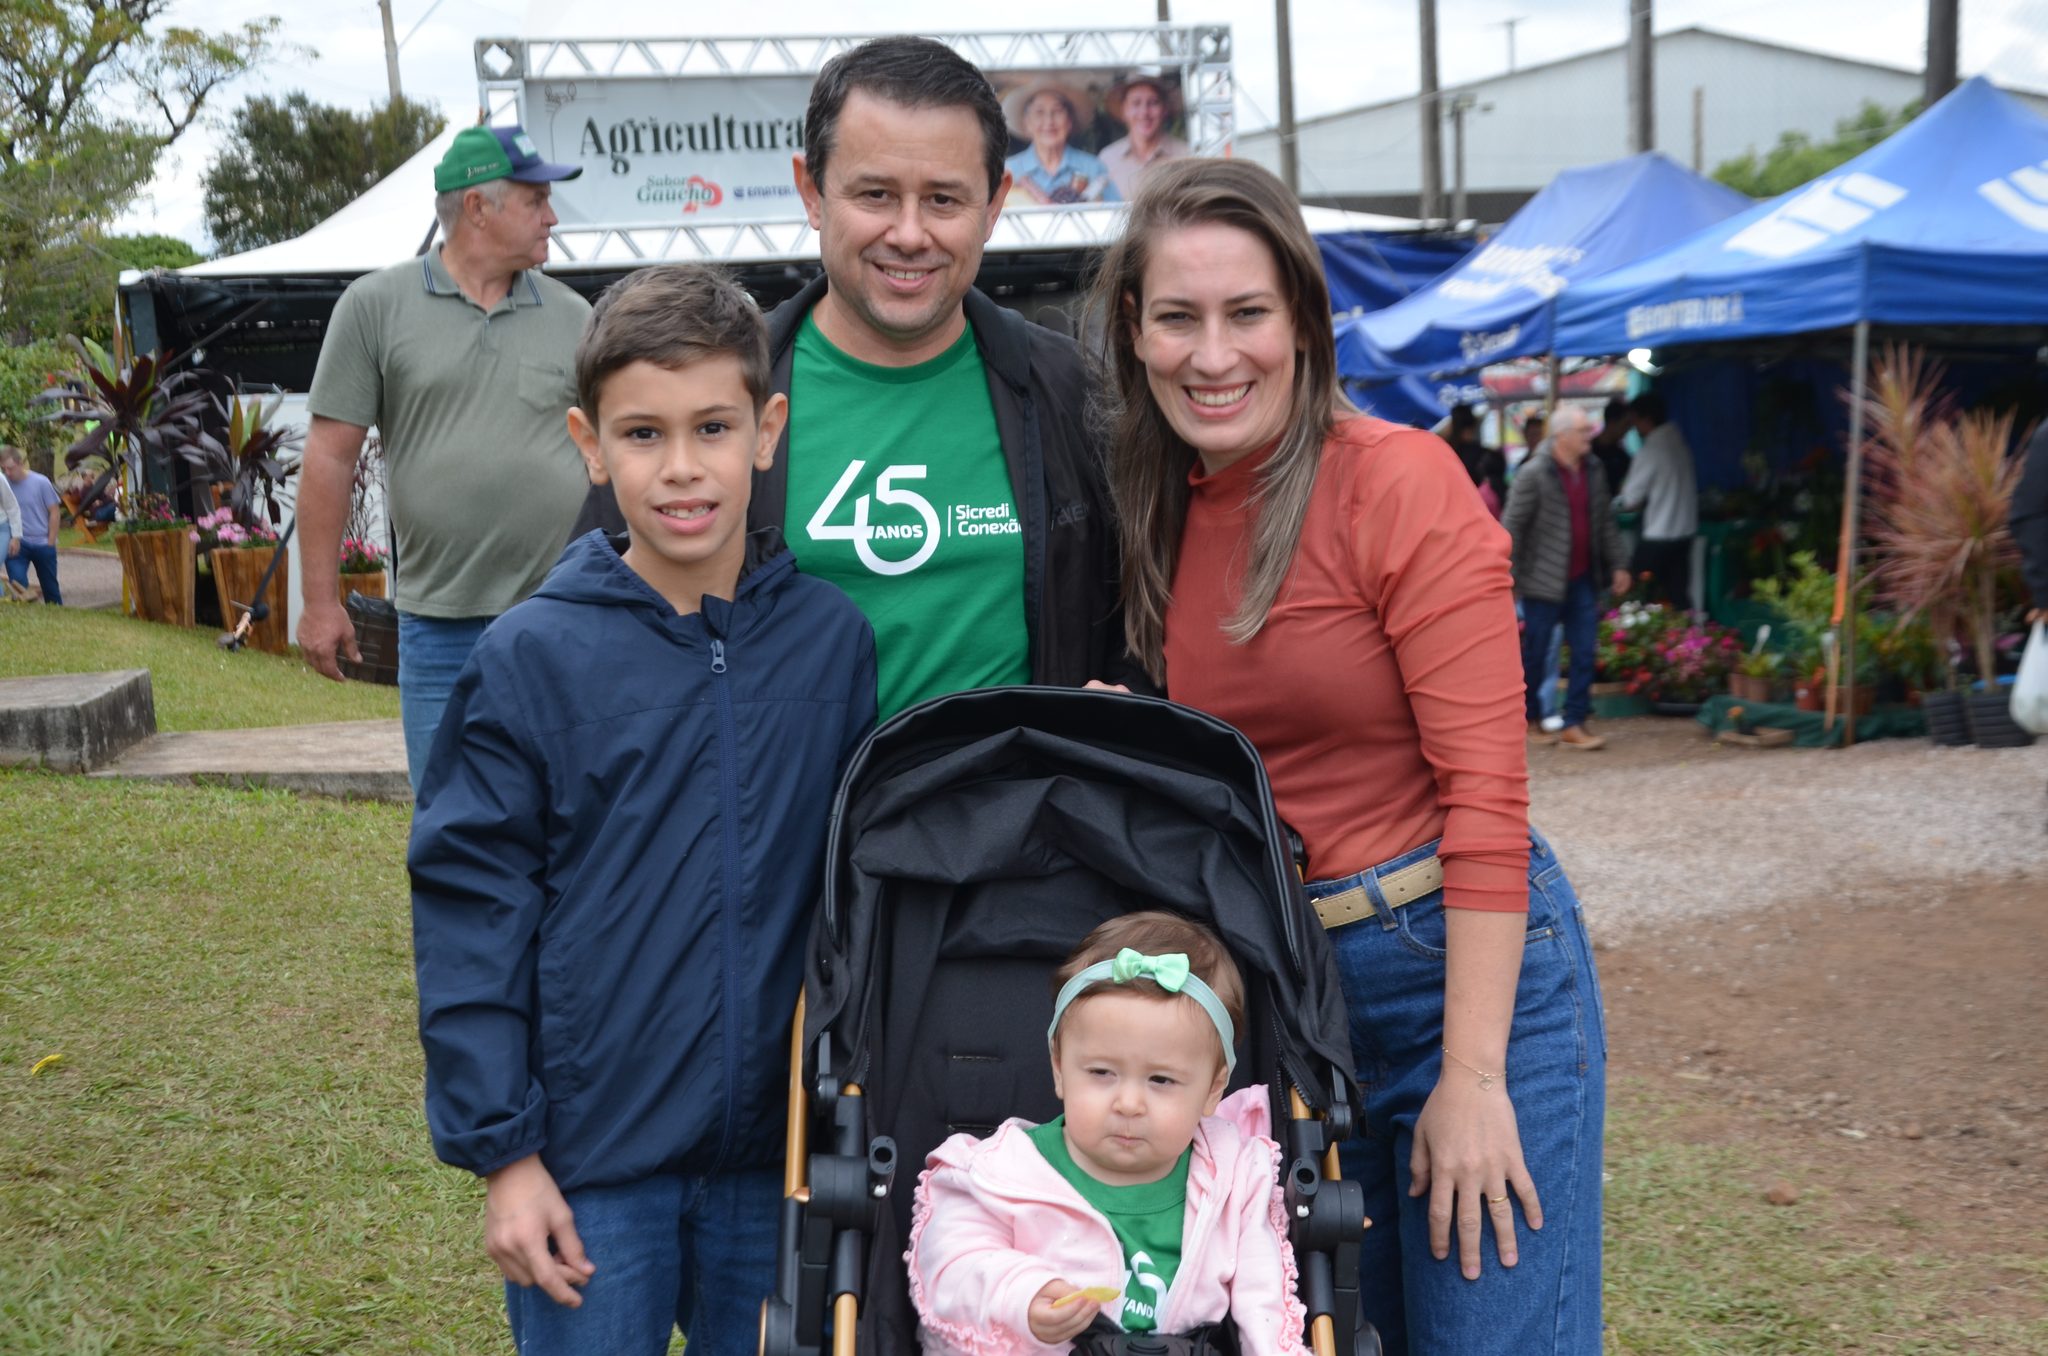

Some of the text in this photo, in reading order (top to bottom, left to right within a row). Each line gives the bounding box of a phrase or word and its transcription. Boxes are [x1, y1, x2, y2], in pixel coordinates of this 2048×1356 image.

[580, 113, 804, 175] Agricultura
[647, 174, 688, 188] Sabor
[806, 459, 941, 576] 45
[955, 503, 1010, 520] Sicredi
[874, 524, 924, 539] ANOS
[957, 518, 1022, 536] Conexã
